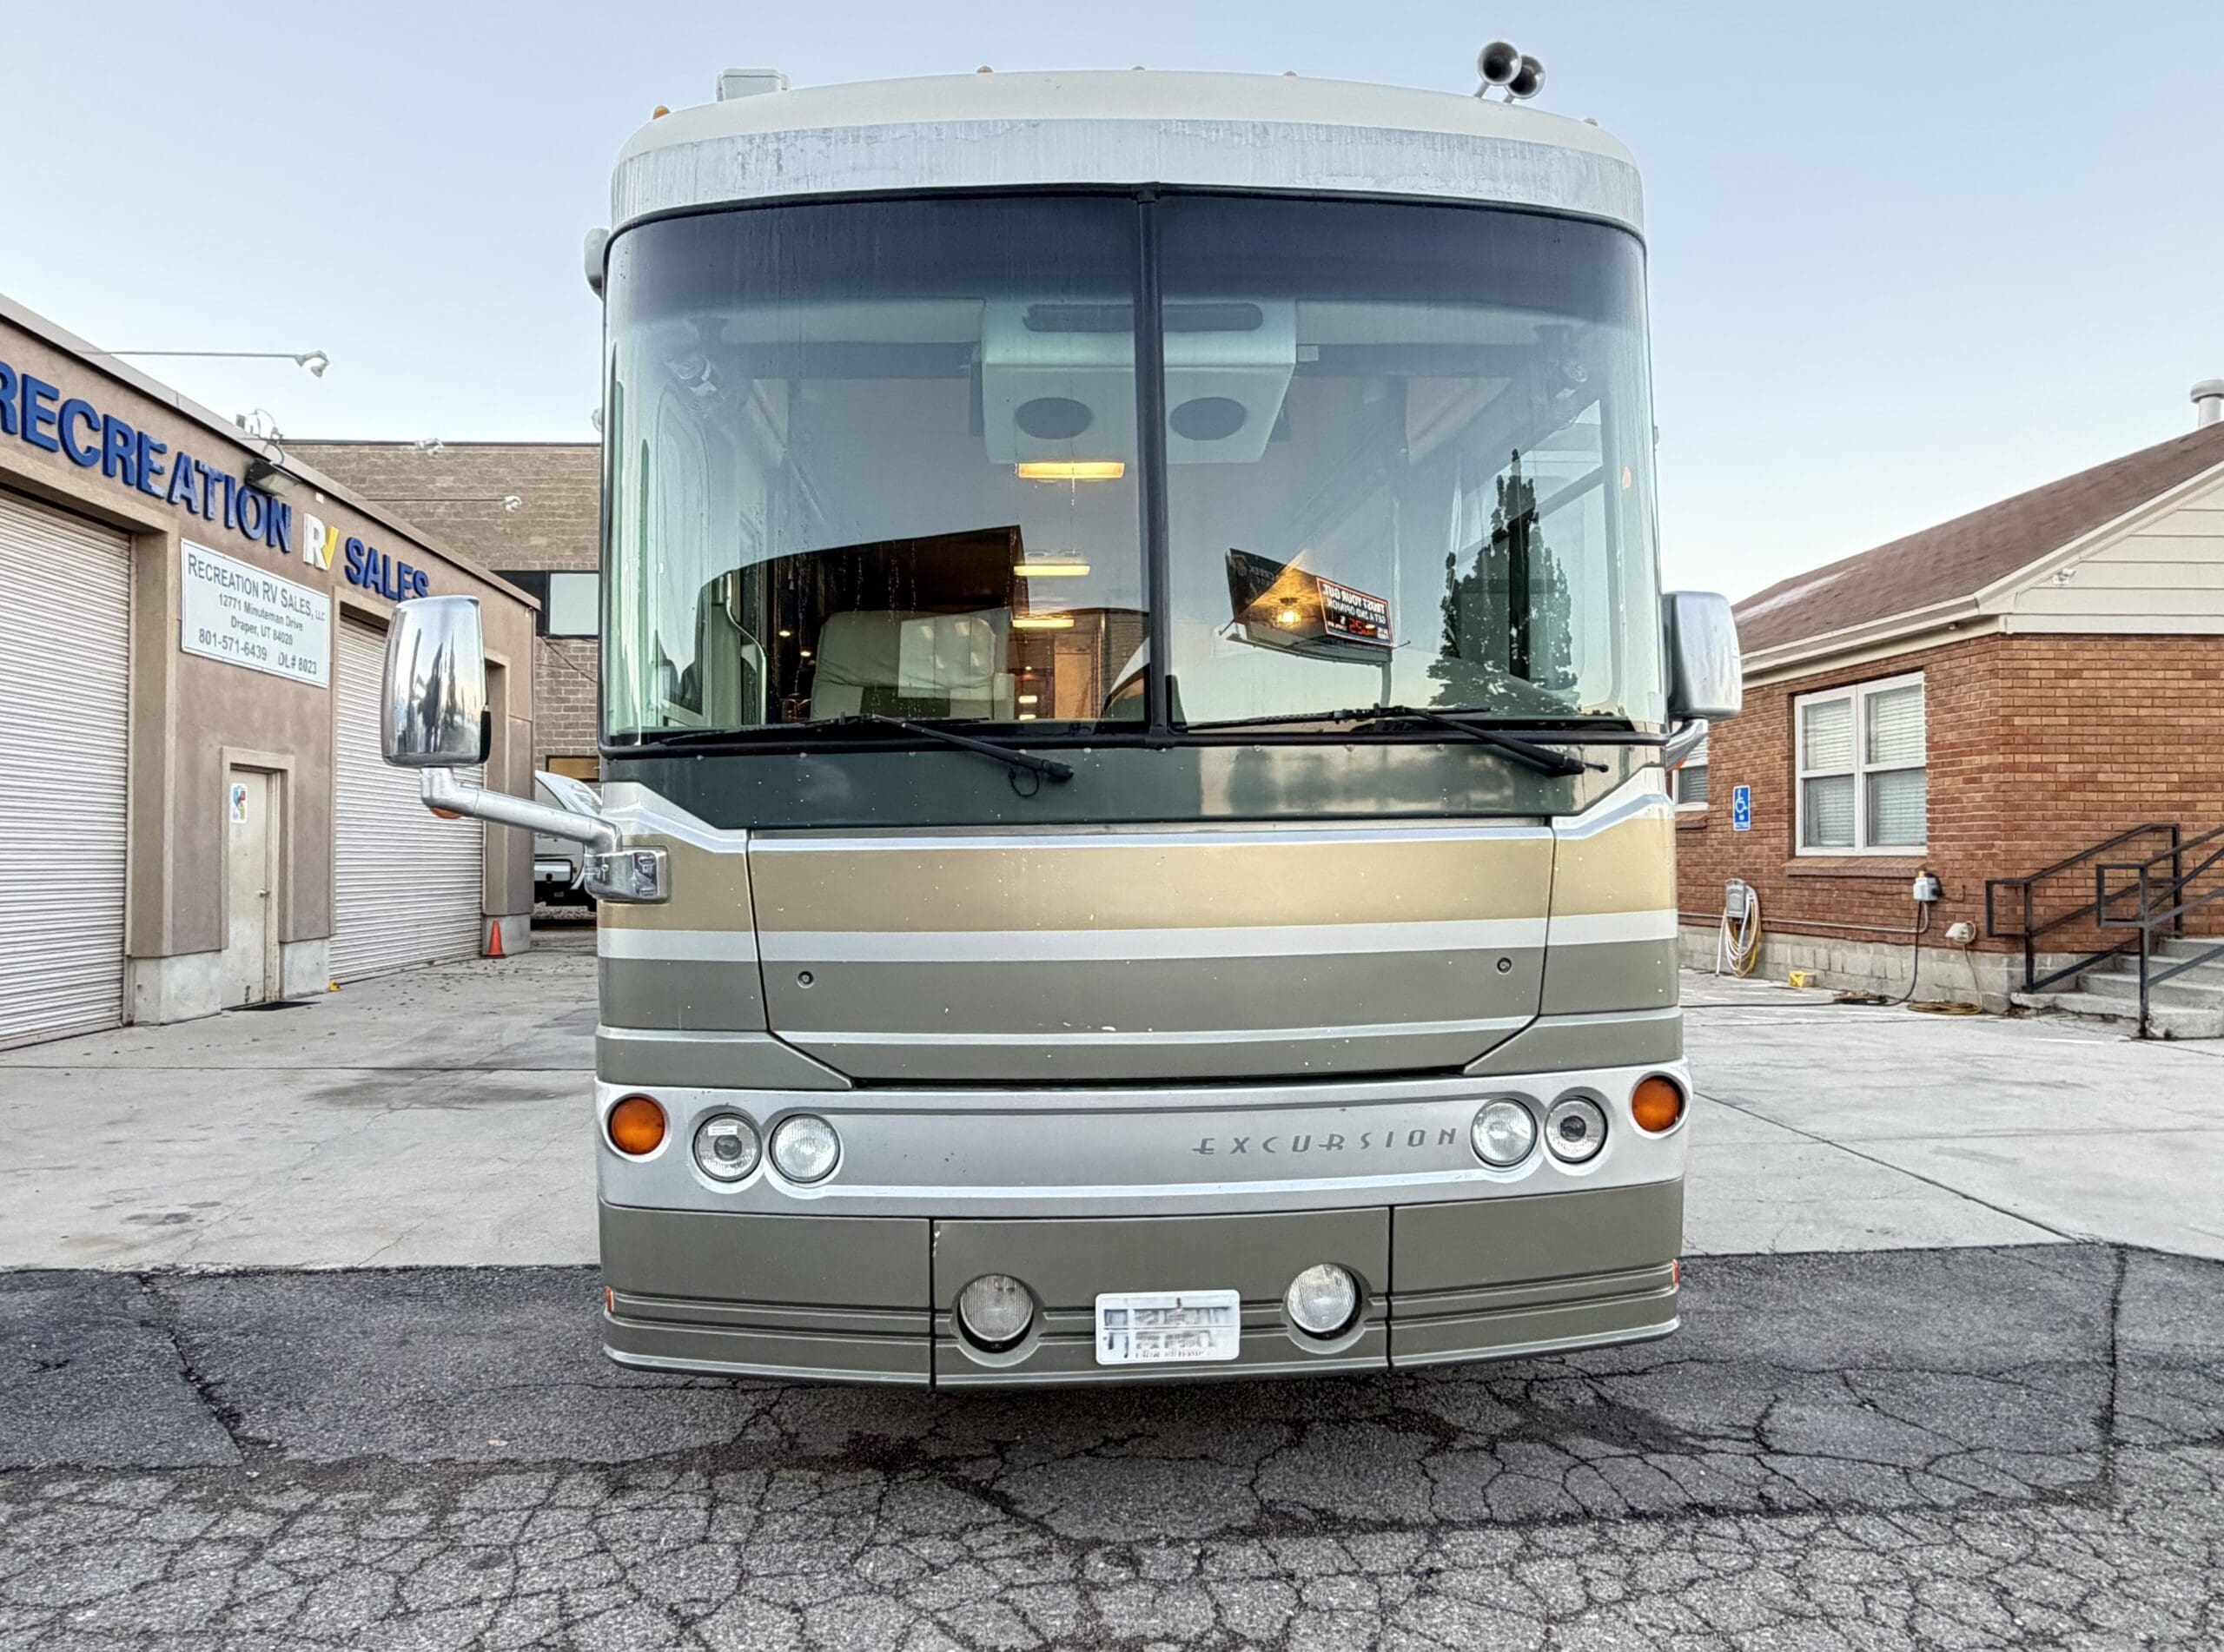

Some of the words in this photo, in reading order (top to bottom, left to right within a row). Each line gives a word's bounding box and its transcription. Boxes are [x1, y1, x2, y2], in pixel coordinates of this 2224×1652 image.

[303, 513, 339, 571] RV
[345, 537, 429, 602] SALES
[188, 553, 260, 598] RECREATION
[262, 580, 278, 605] RV
[281, 588, 314, 620] SALES,
[315, 609, 325, 622] LLC
[219, 593, 242, 611] 12771
[244, 601, 284, 626] Minuteman
[286, 615, 303, 632] Drive
[231, 615, 260, 637] Draper,
[261, 624, 271, 639] UT
[273, 629, 294, 646] 84020
[198, 627, 268, 661] 801-571-6439
[278, 651, 296, 670] DL#
[298, 658, 318, 676] 8023
[1192, 1127, 1457, 1155] EXCURSION
